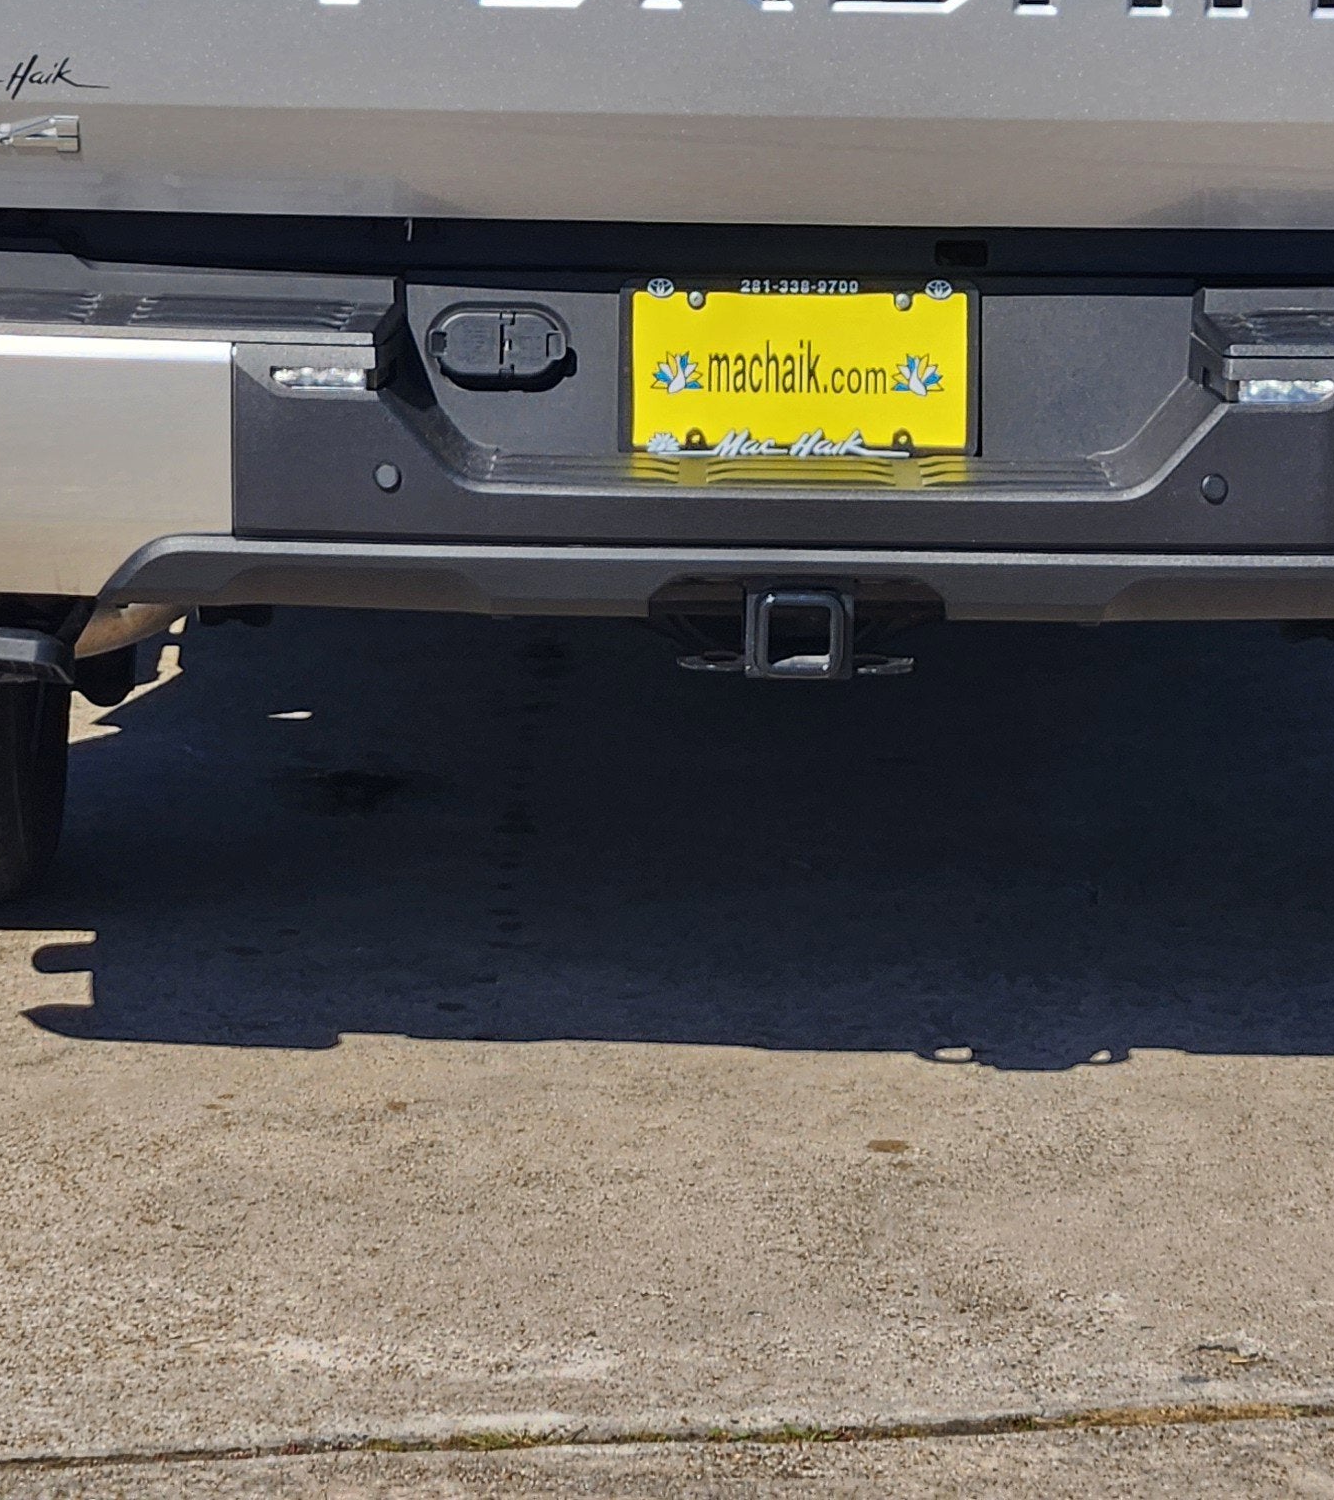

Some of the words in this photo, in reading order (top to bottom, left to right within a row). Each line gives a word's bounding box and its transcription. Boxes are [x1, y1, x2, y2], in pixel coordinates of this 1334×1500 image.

[5, 54, 109, 100] Haik
[740, 279, 859, 294] 281-338-9700
[707, 340, 887, 394] machaik.com
[715, 429, 788, 456] Mac
[788, 428, 908, 457] Haik
